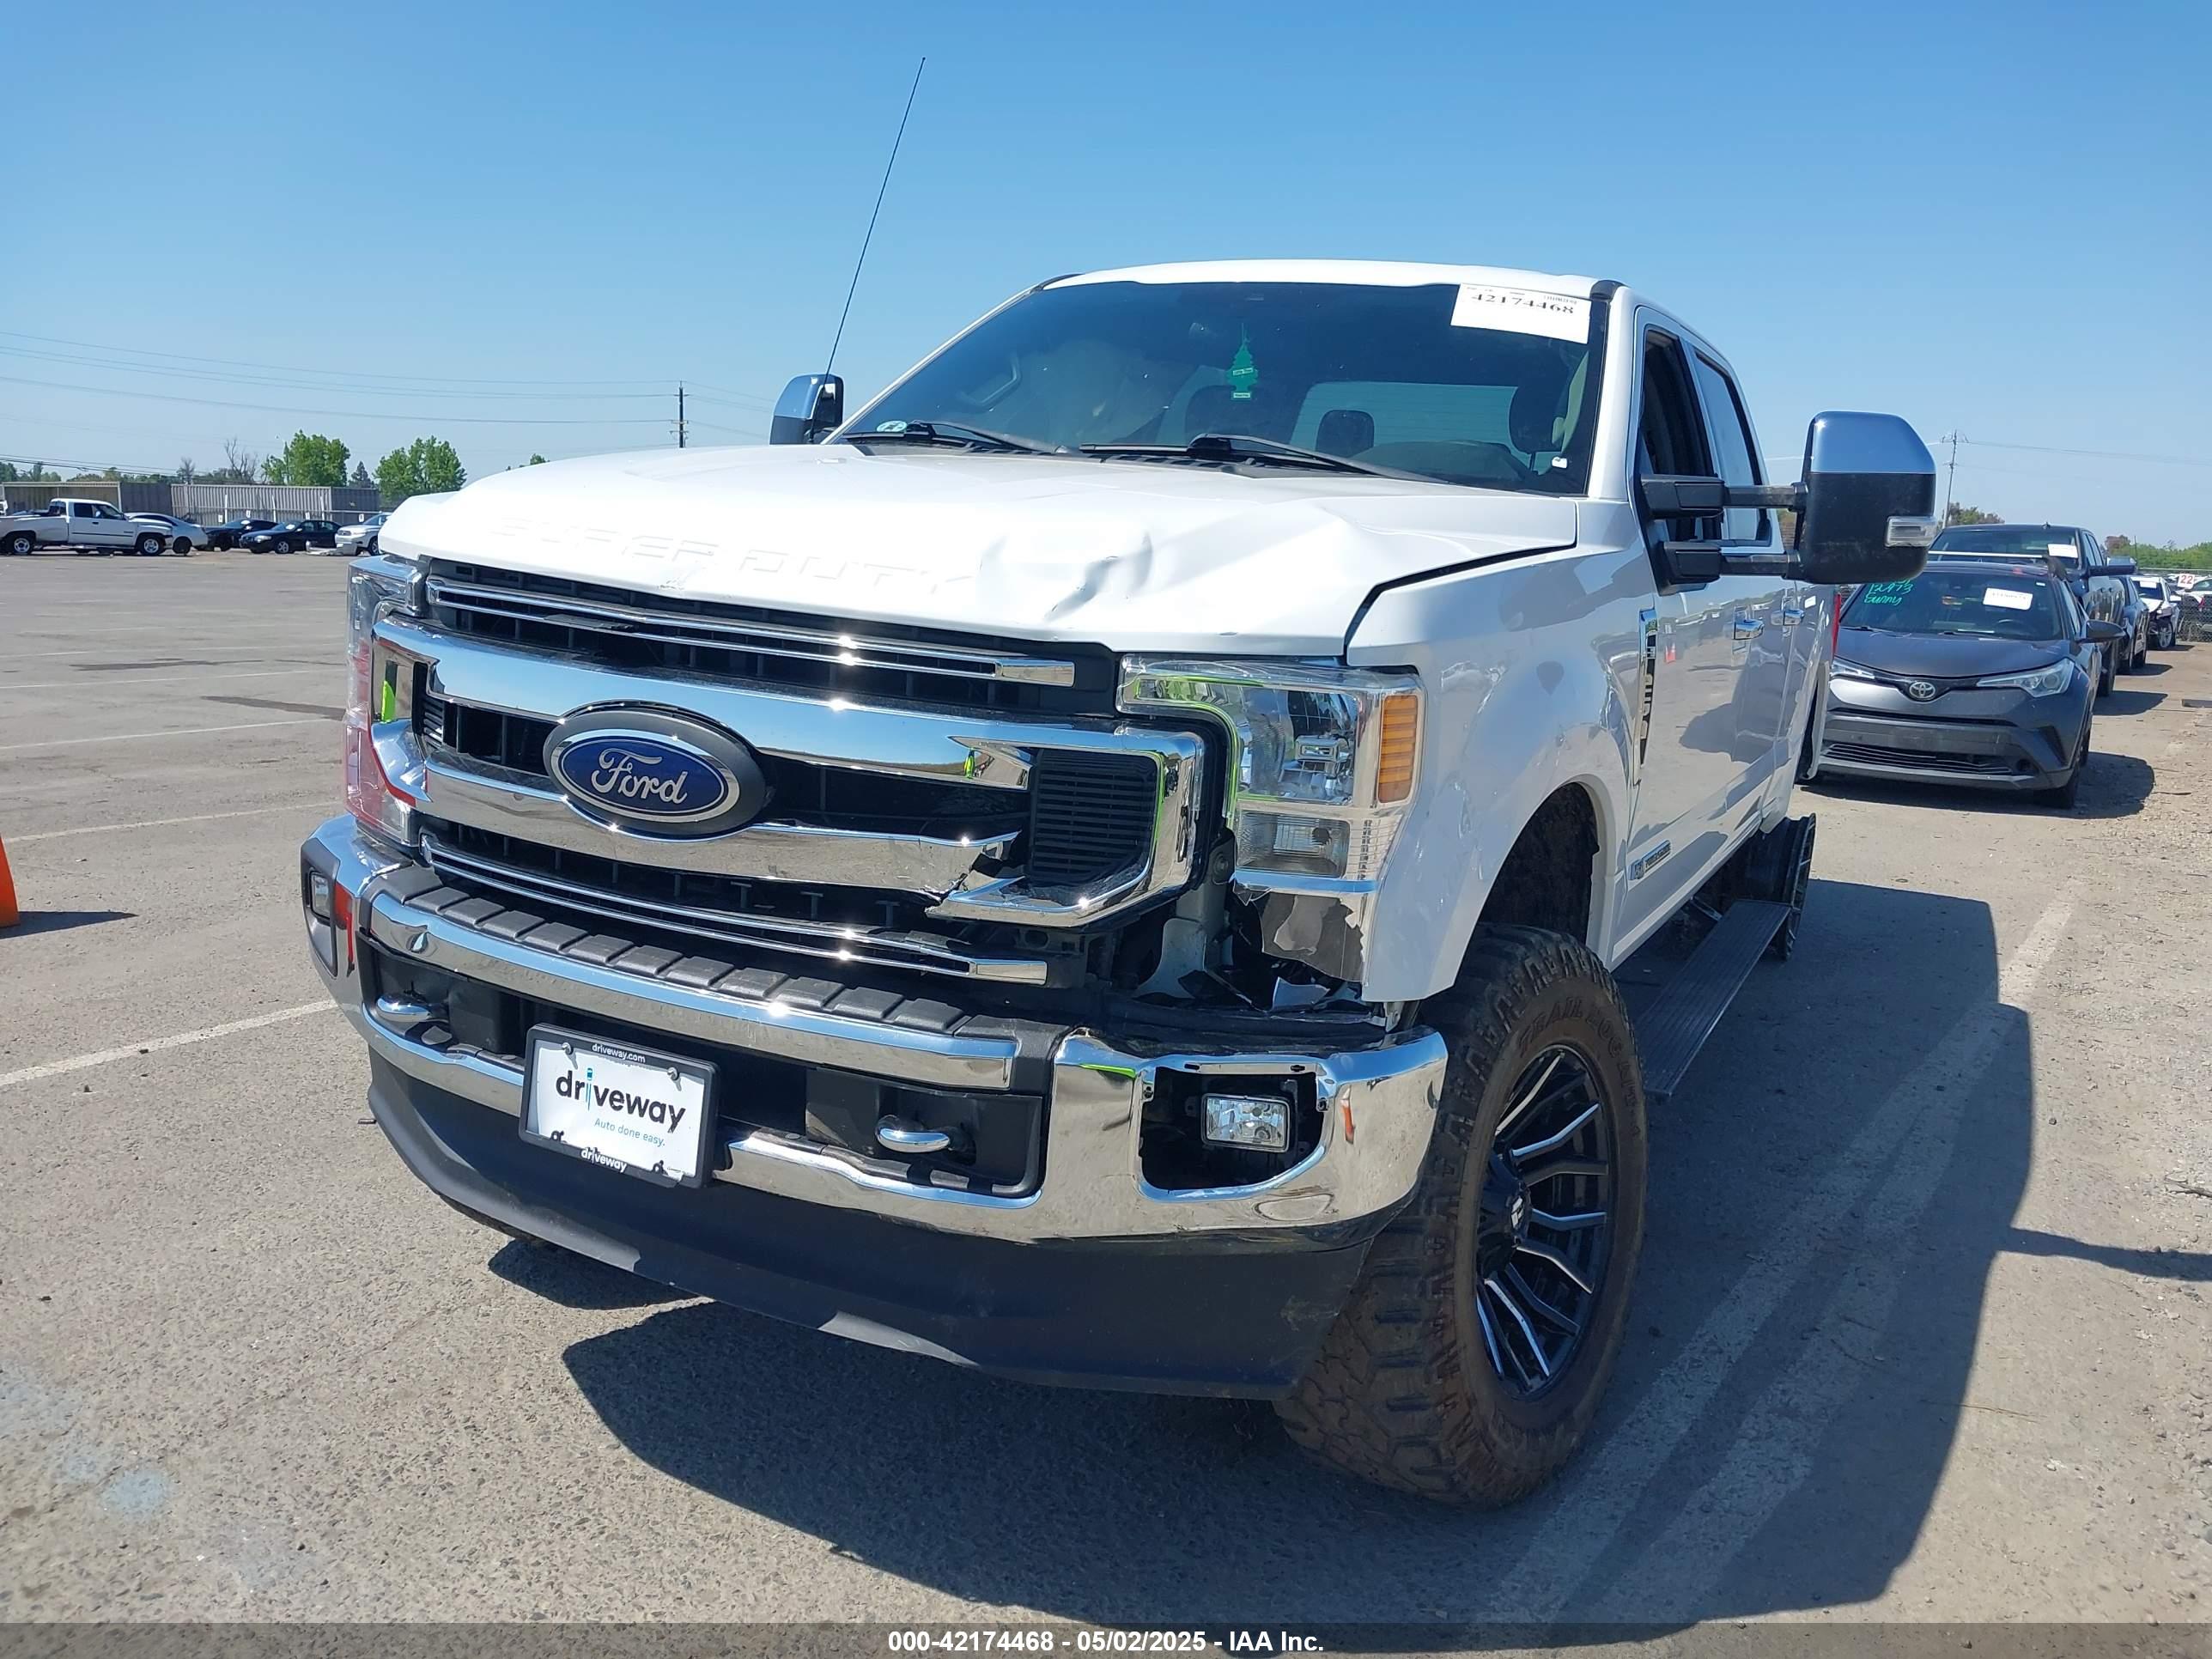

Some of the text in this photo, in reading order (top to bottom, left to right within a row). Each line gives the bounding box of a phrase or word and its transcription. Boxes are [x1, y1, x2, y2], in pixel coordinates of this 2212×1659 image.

[1471, 293, 1574, 314] 42174468
[489, 515, 975, 594] SUPER DUTY
[2180, 574, 2193, 585] 22
[591, 748, 689, 805] Ford
[592, 1042, 646, 1064] driveway.com
[556, 1067, 686, 1133] driveway
[594, 1117, 665, 1148] Auto done easy.
[580, 1147, 628, 1173] driveway
